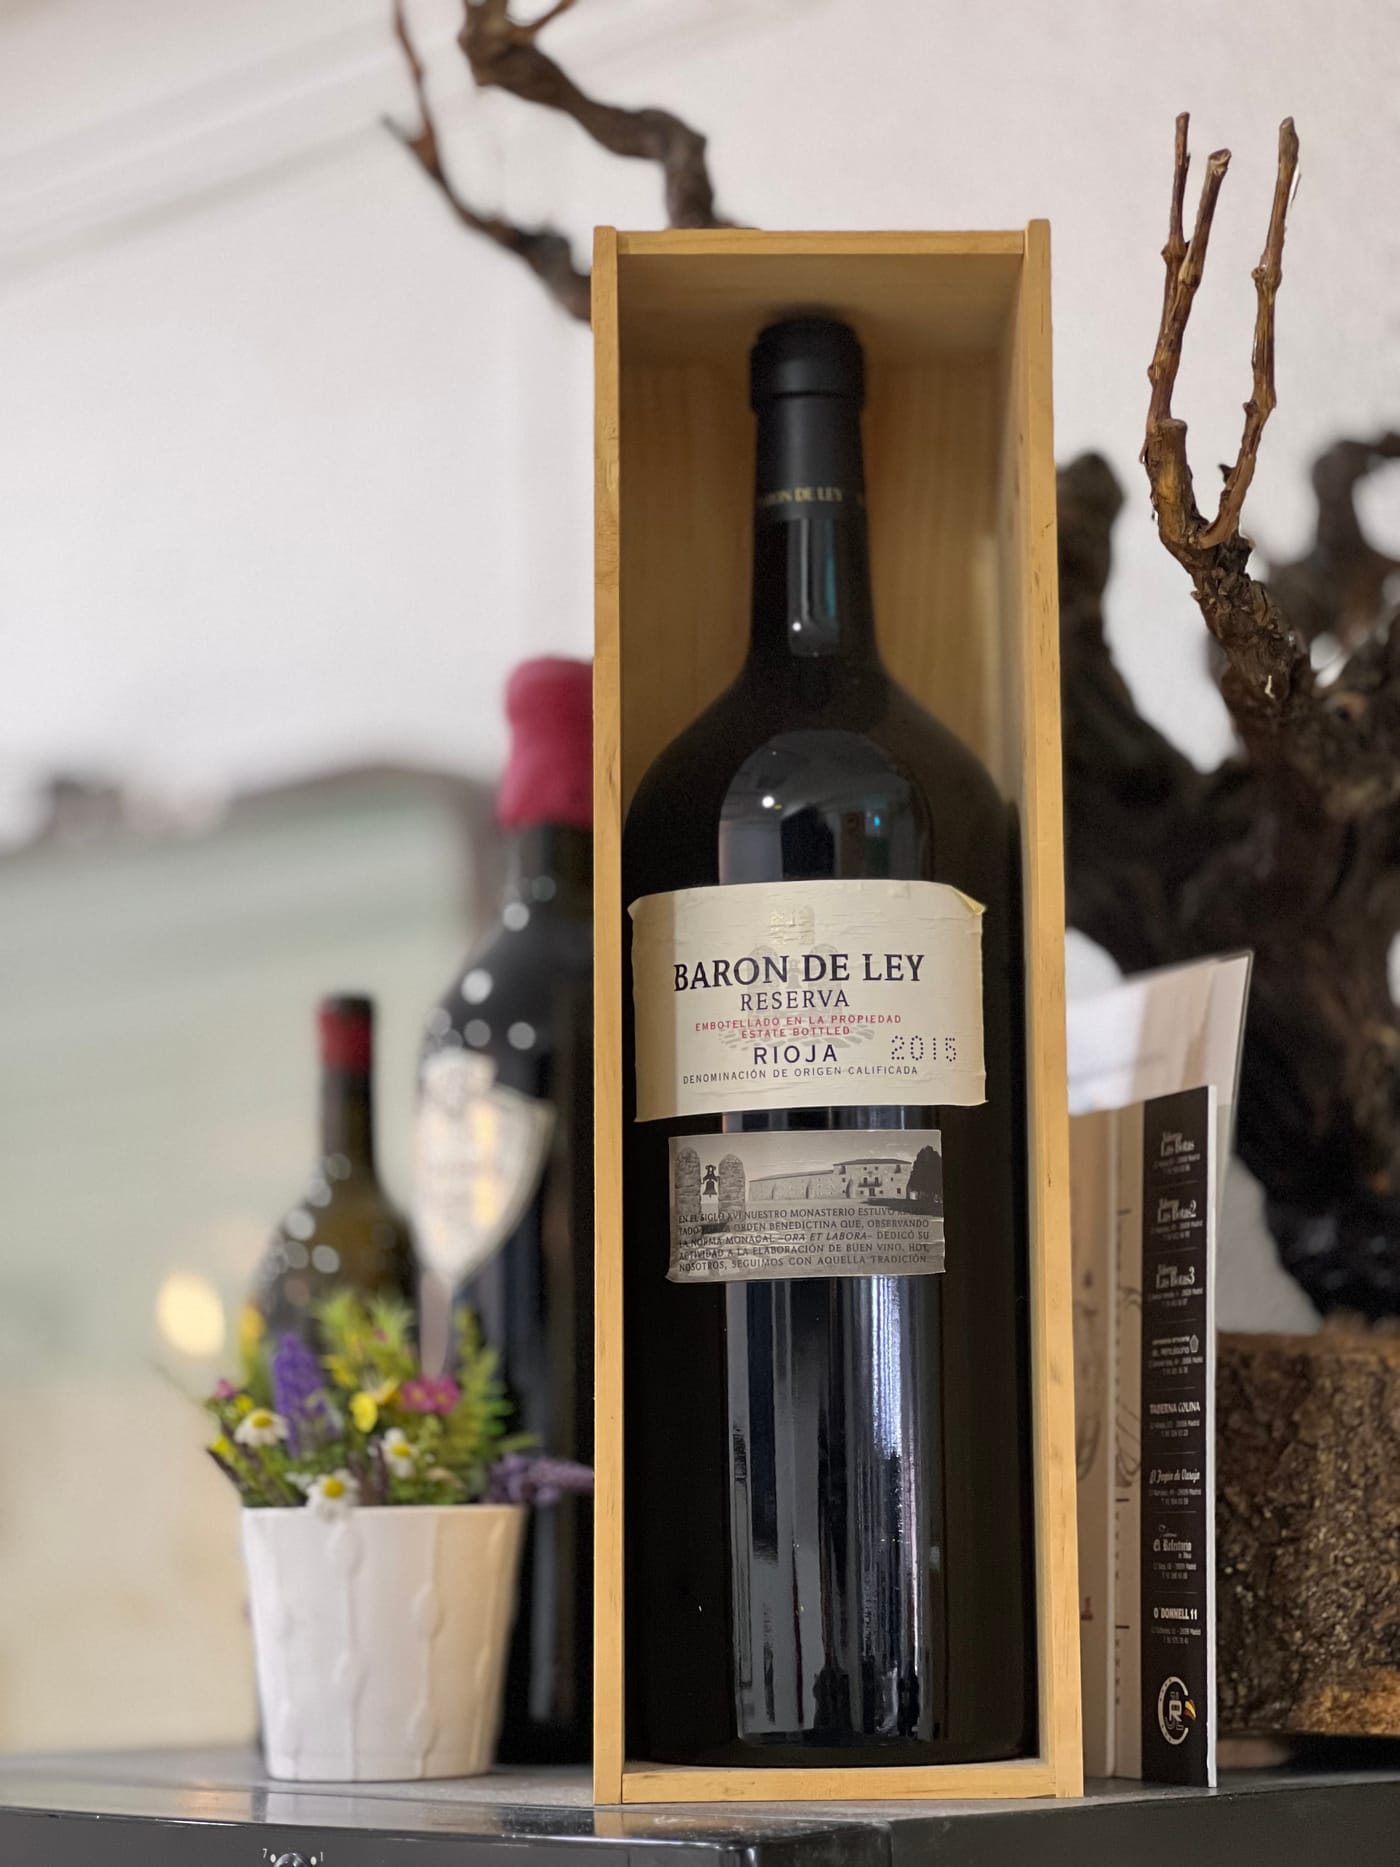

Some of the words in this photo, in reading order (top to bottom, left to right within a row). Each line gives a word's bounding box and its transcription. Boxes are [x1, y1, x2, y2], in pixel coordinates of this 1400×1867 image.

[673, 954, 790, 992] BARON
[803, 953, 851, 982] DE
[862, 953, 926, 983] LEY
[740, 989, 850, 1011] RESERVA
[695, 1017, 781, 1032] EMBOTELLADO
[786, 1016, 803, 1026] EN
[808, 1015, 825, 1025] LA
[830, 1014, 902, 1025] PROPIEDAD
[741, 1028, 787, 1040] ESTATE
[792, 1026, 851, 1037] BOTTLED
[753, 1044, 839, 1066] RIOJA
[890, 1034, 959, 1062] 2015
[682, 1067, 767, 1085] DENOMINACIÓN
[772, 1068, 789, 1079] DE
[794, 1067, 842, 1078] ORIGEN
[848, 1065, 919, 1076] CALIFICADA
[700, 1211, 725, 1222] SIGLO
[743, 1209, 788, 1220] NUESTRO
[789, 1207, 856, 1218] MONASTERIO
[858, 1206, 895, 1216] ESTUVO
[734, 1222, 766, 1232] ORDEN
[769, 1219, 840, 1231] BENEDICTINA
[840, 1219, 865, 1229] QUE,
[867, 1218, 930, 1229] OBSERVANDO
[725, 1234, 776, 1246] MONACAL
[809, 1232, 823, 1241] ET
[876, 1229, 915, 1240] DEDICÓ
[918, 1231, 930, 1240] SU
[727, 1249, 734, 1257] A
[737, 1247, 749, 1256] LA
[753, 1243, 825, 1255] ELABORACIÓN
[828, 1244, 841, 1253] DE
[846, 1243, 873, 1253] BUEN
[679, 1260, 728, 1272] NOSOTROS,
[731, 1257, 784, 1269] SEGUIMOS
[788, 1256, 813, 1266] CON
[817, 1255, 866, 1265] AQUELLA
[871, 1254, 927, 1264] TRADICIÓN
[262, 1848, 268, 1859] 7
